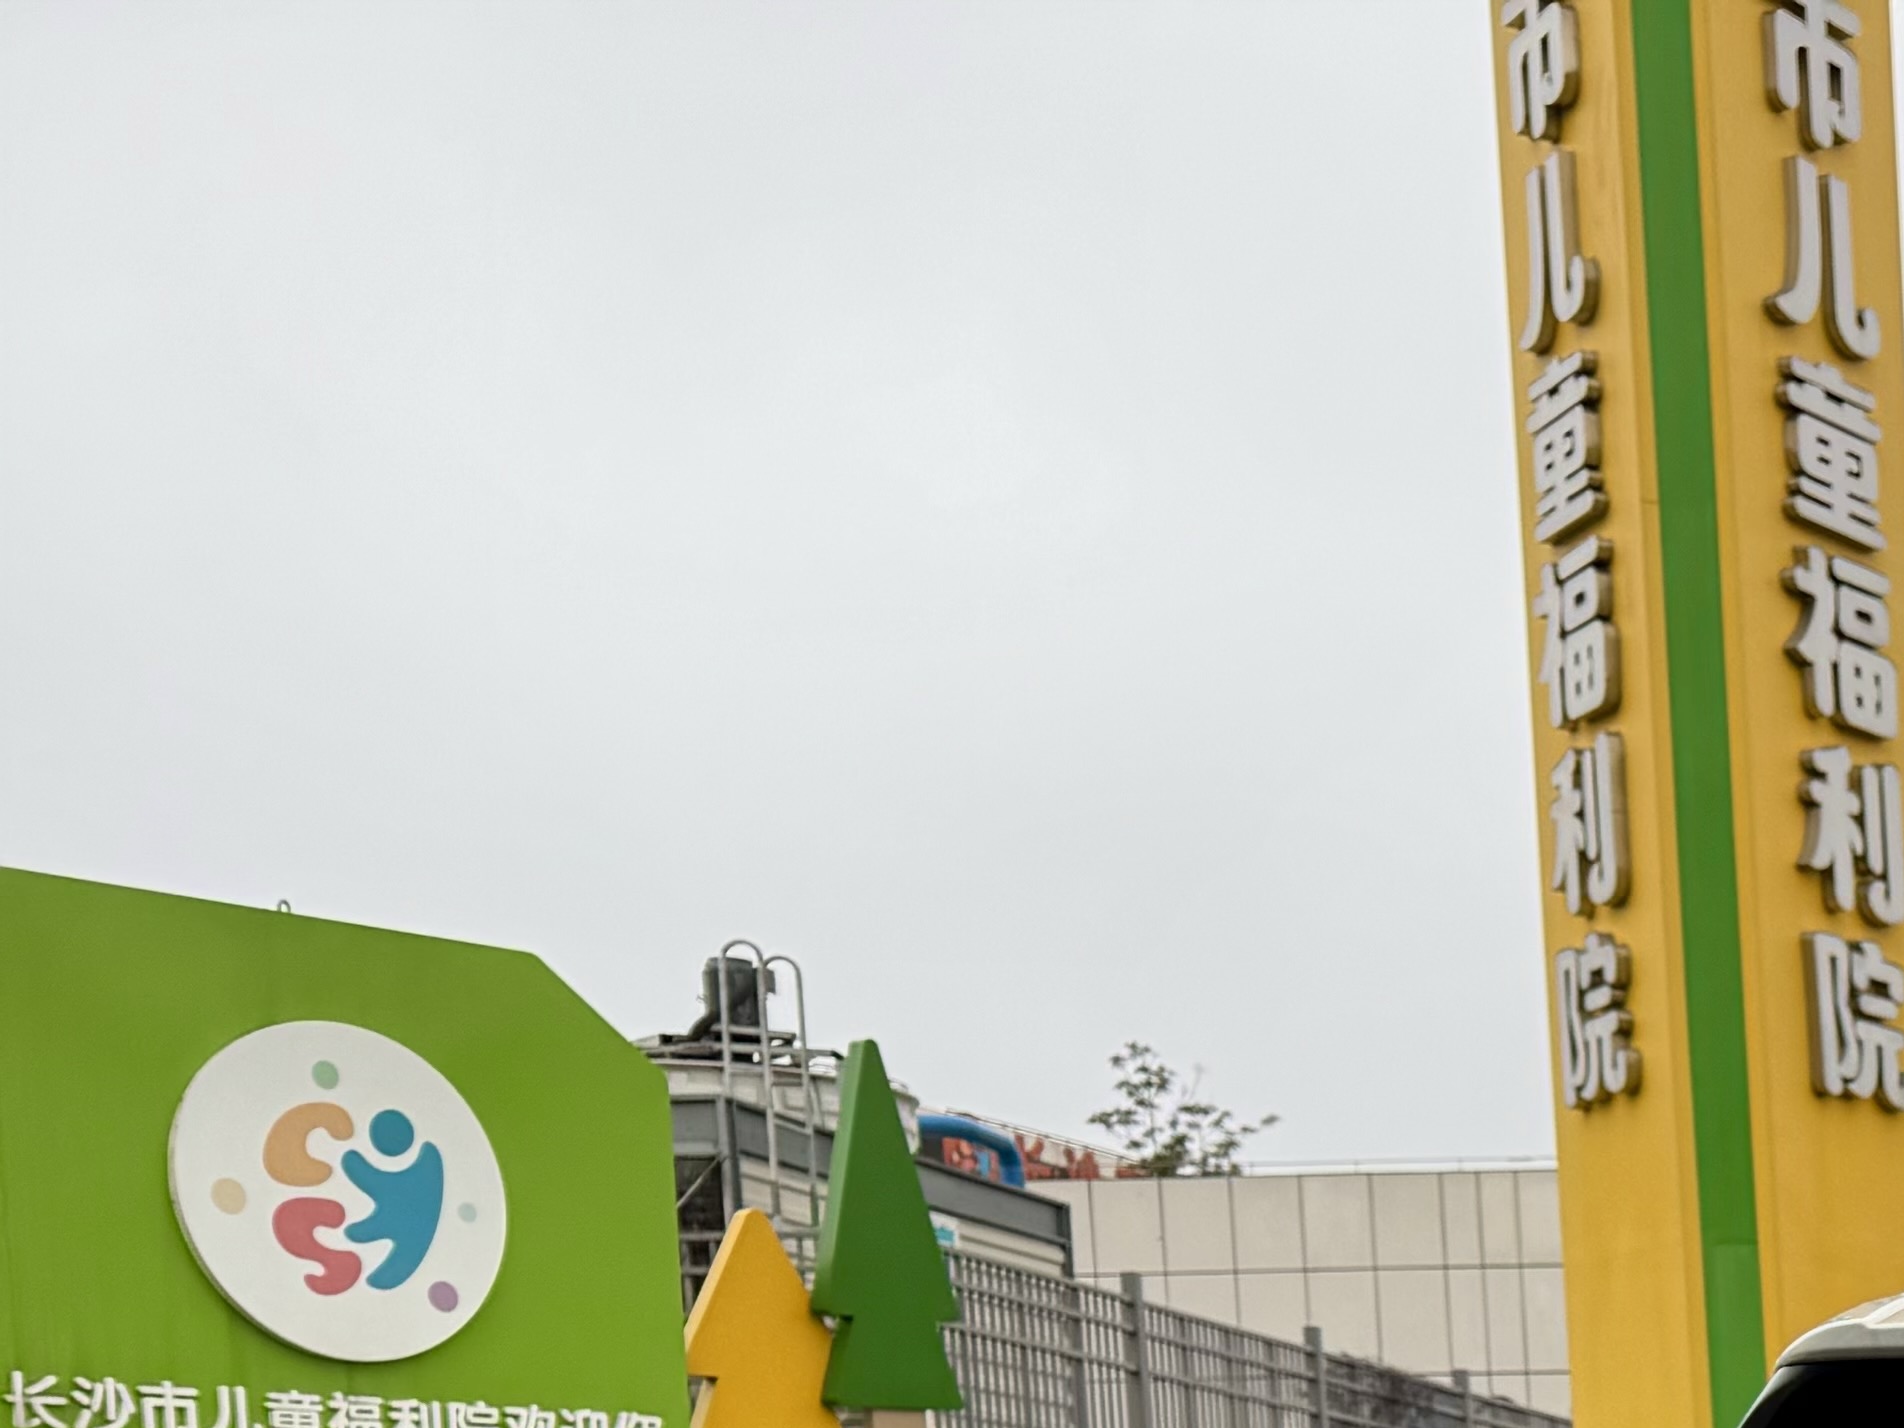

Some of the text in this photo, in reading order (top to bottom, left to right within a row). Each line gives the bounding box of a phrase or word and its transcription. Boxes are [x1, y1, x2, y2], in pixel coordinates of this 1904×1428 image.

[1502, 0, 1642, 1110] 市儿童福利院
